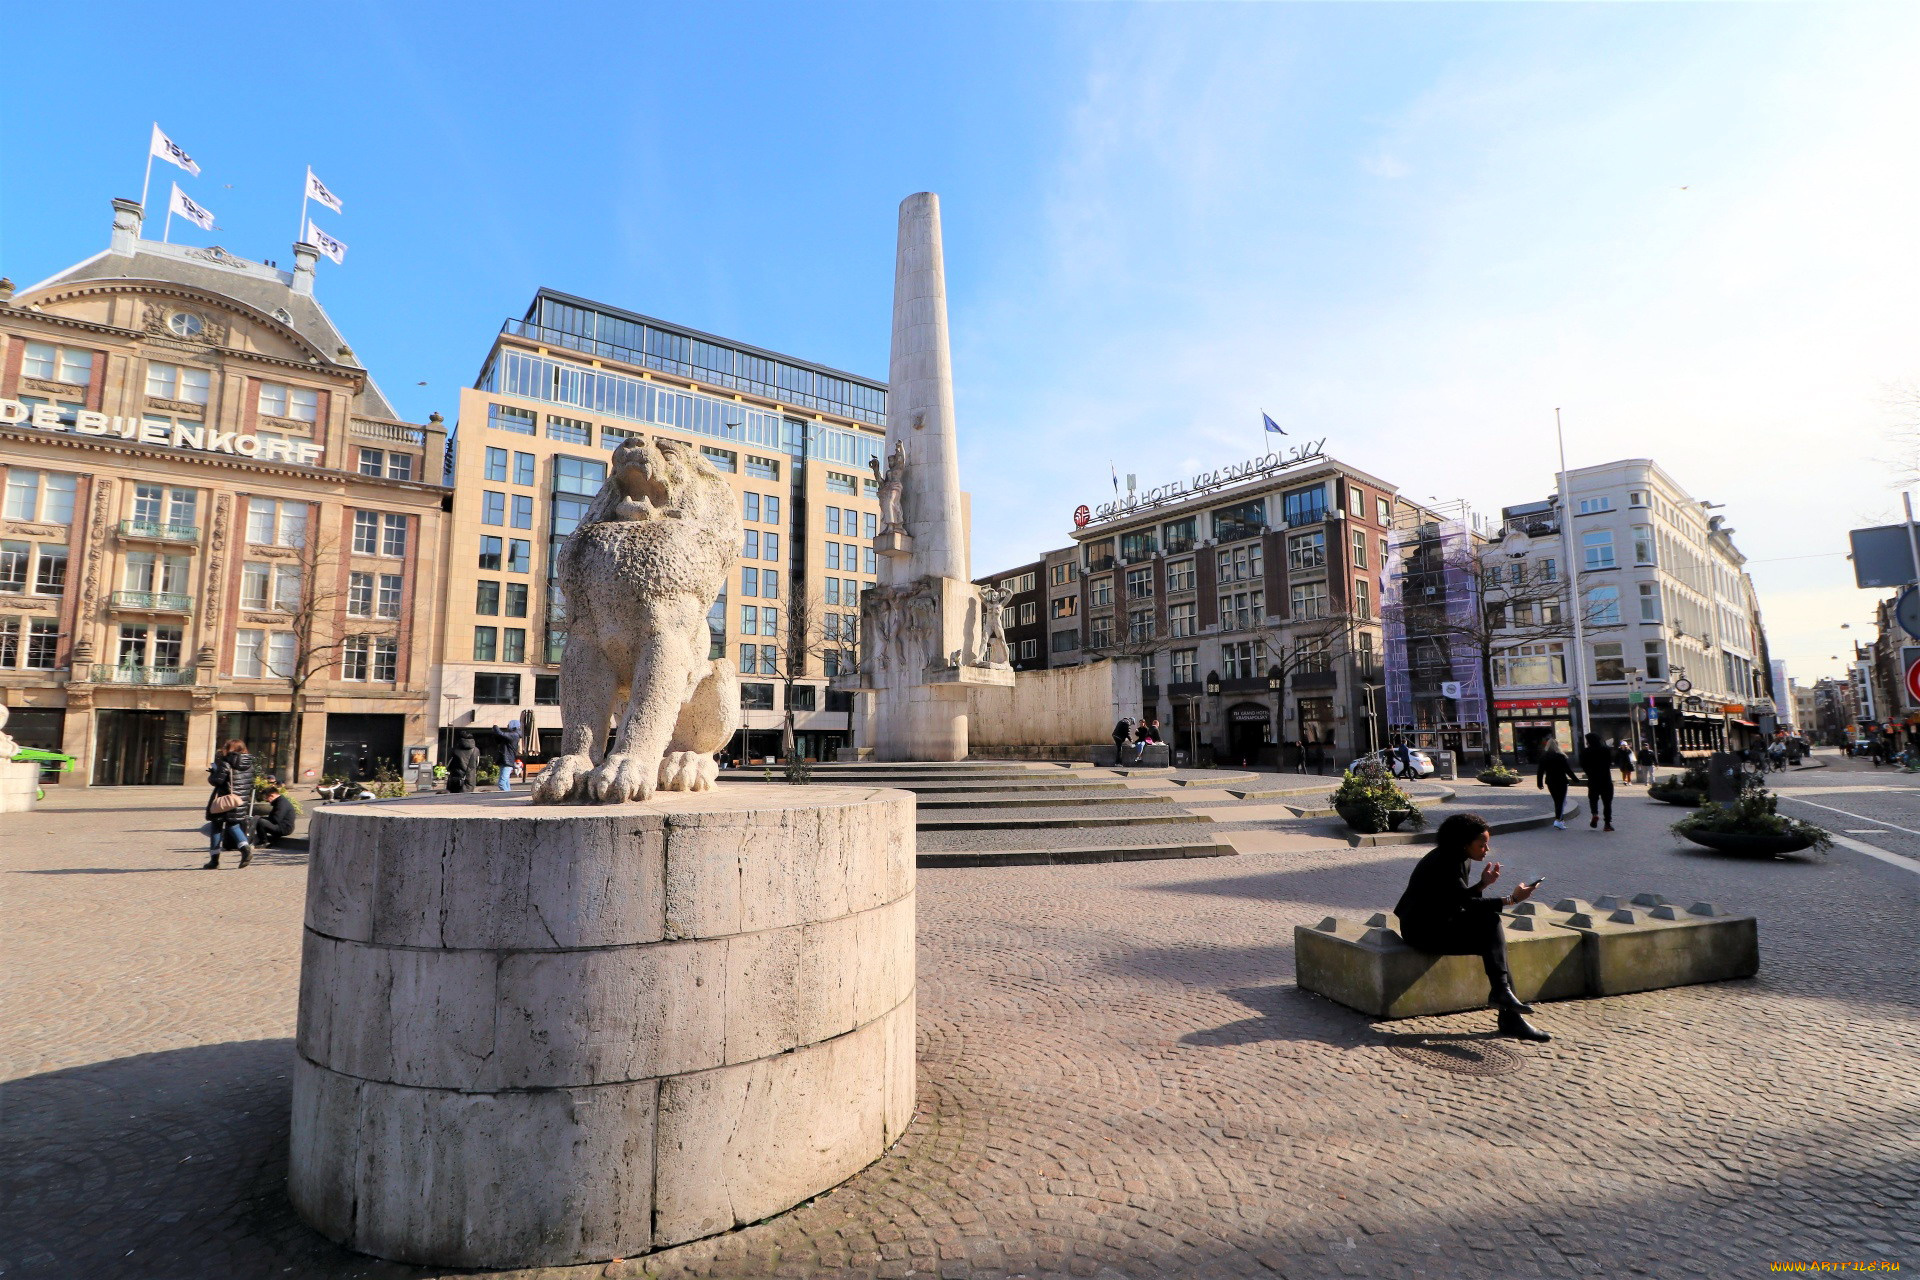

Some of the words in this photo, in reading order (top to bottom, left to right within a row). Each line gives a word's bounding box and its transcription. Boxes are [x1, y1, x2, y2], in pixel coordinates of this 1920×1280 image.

[0, 399, 68, 431] DE
[1095, 494, 1138, 518] GRAND
[1141, 480, 1188, 505] HOTEL
[1192, 437, 1327, 490] KRASNAPOLSKY
